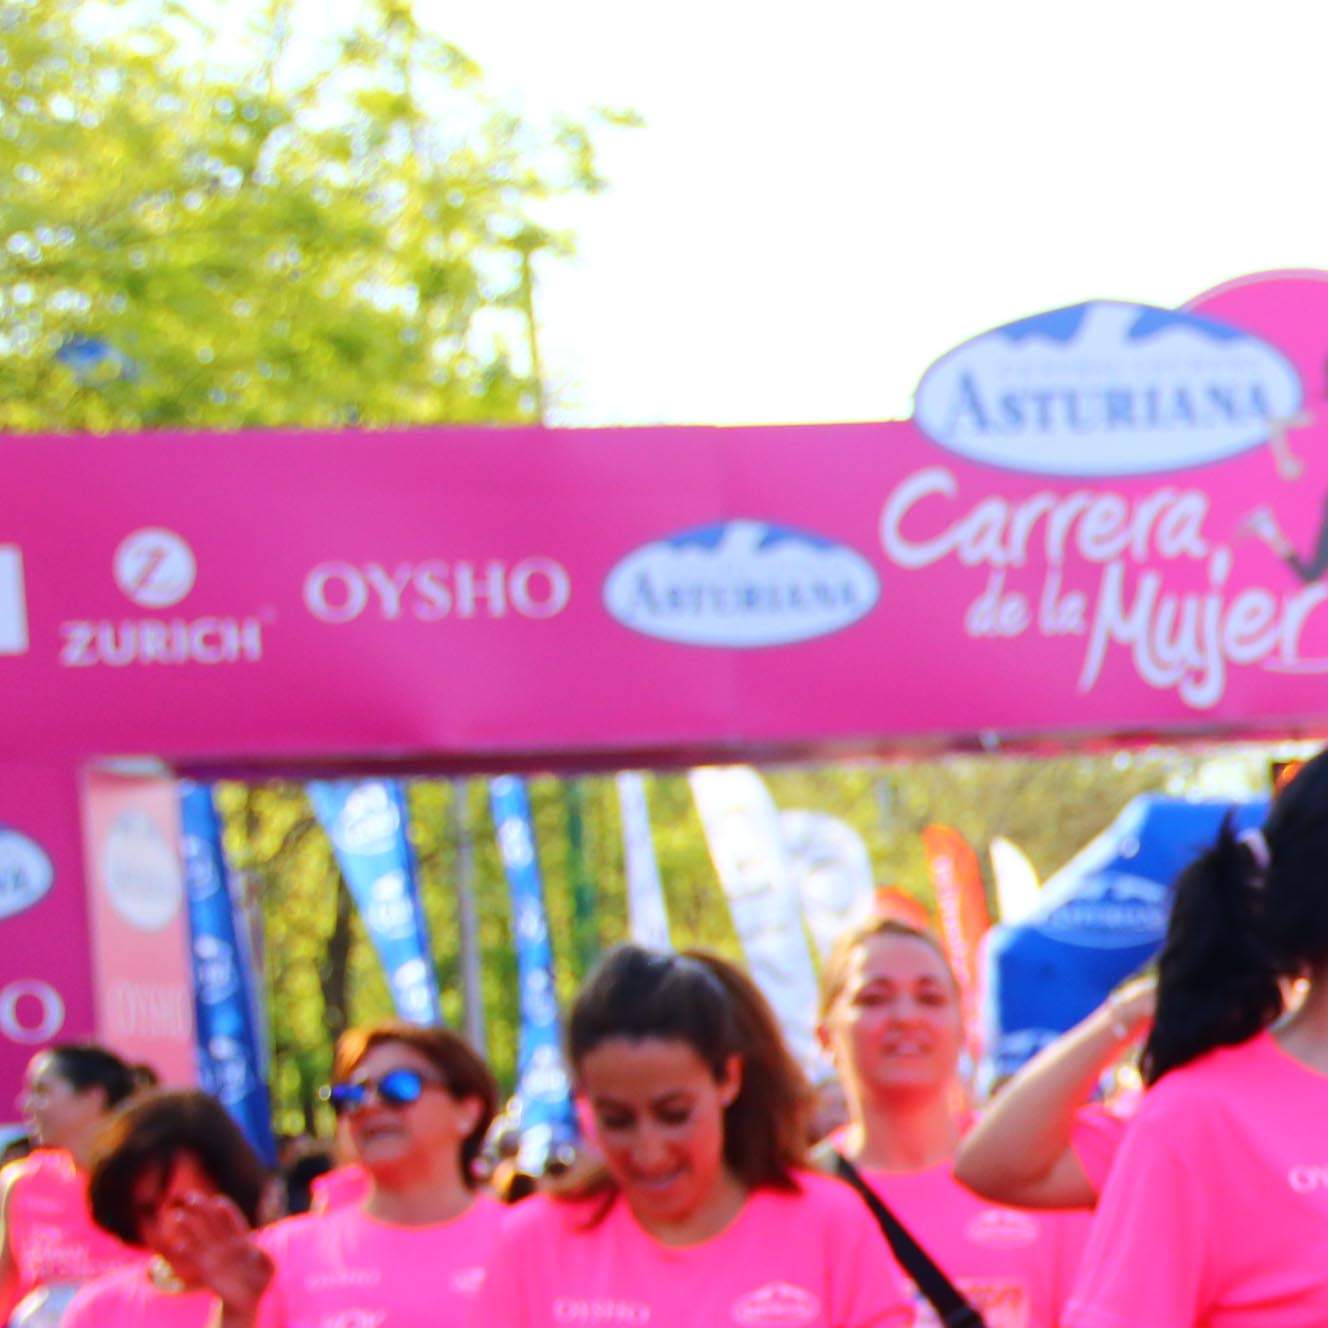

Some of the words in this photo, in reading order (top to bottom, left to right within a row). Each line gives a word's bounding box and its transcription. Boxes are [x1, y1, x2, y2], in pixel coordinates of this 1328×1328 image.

[949, 368, 1271, 441] ASTURIANA
[880, 466, 1208, 568] Carrera
[303, 557, 569, 623] OYSHO
[624, 562, 862, 619] ASTURIANA
[965, 565, 1031, 637] de
[1038, 562, 1086, 634] la
[60, 618, 262, 666] ZURICH
